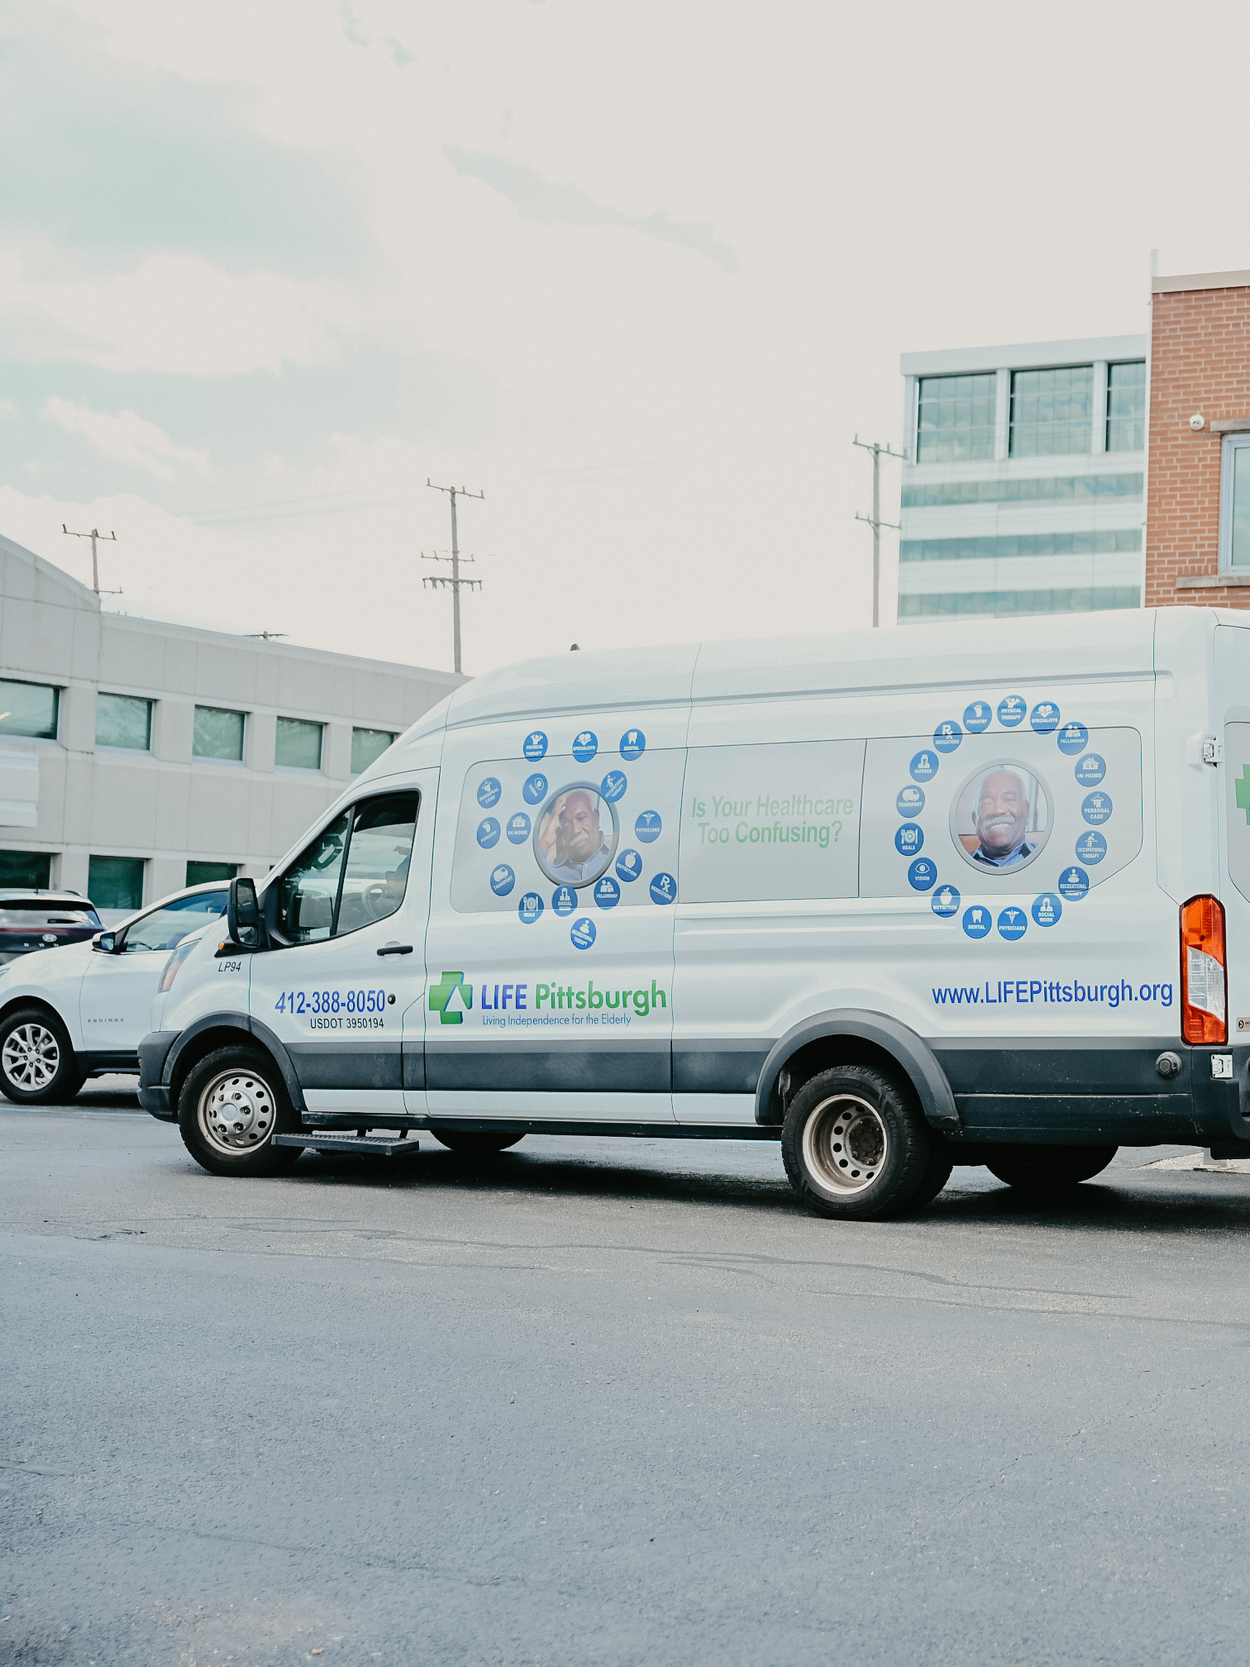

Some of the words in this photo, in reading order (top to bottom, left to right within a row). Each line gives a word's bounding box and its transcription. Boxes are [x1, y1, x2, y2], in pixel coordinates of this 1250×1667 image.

[691, 797, 706, 818] Is
[711, 795, 752, 818] Your
[756, 794, 854, 817] Healthcare
[698, 822, 731, 844] Too
[735, 819, 843, 849] Confusing?
[218, 961, 242, 973] LP94
[275, 989, 386, 1014] 412-388-8050
[481, 984, 528, 1010] LIFE
[535, 979, 667, 1017] Pittsburgh
[932, 978, 1173, 1008] www.LIFEPittsburgh.org
[310, 1017, 343, 1029] USDOT
[346, 1017, 385, 1029] 3950194
[482, 1015, 506, 1029] Living
[507, 1014, 570, 1028] Independence
[571, 1013, 584, 1025] for
[585, 1014, 599, 1025] the
[601, 1012, 632, 1027] Elderly
